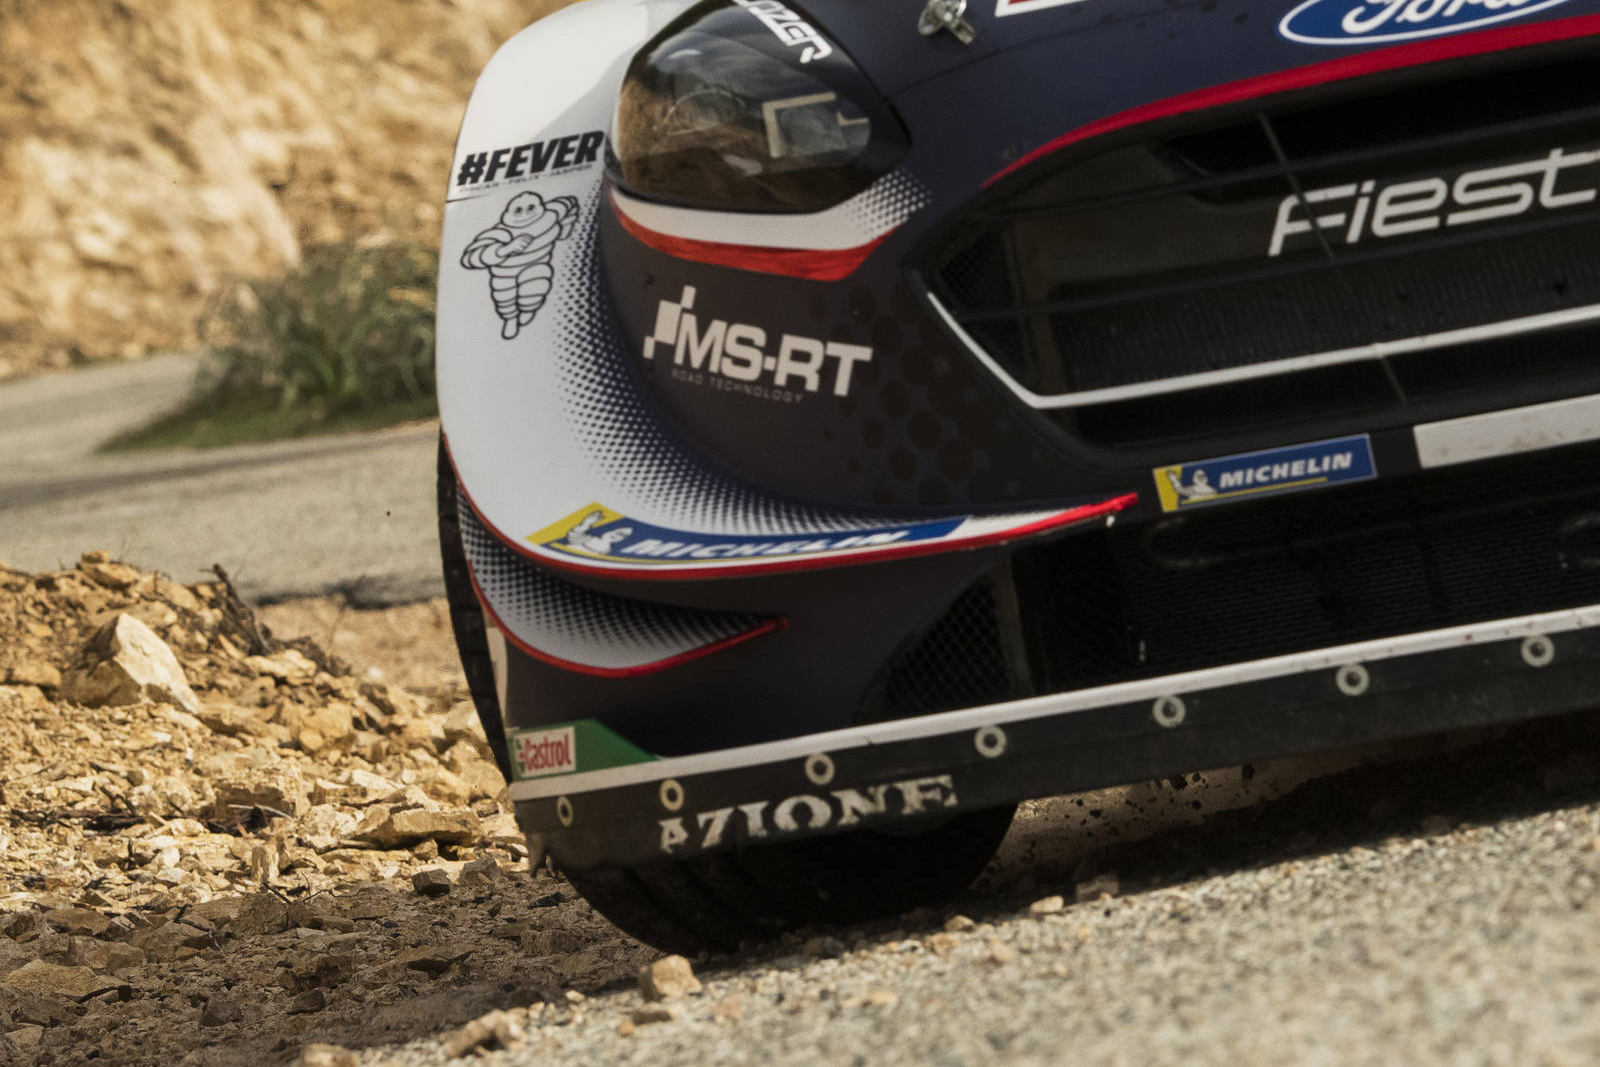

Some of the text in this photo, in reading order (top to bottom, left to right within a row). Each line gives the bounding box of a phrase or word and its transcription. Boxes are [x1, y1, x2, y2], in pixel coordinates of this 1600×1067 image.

[456, 130, 604, 186] #FEVER
[1218, 451, 1352, 490] MICHELIN
[620, 530, 910, 558] MICHELIN
